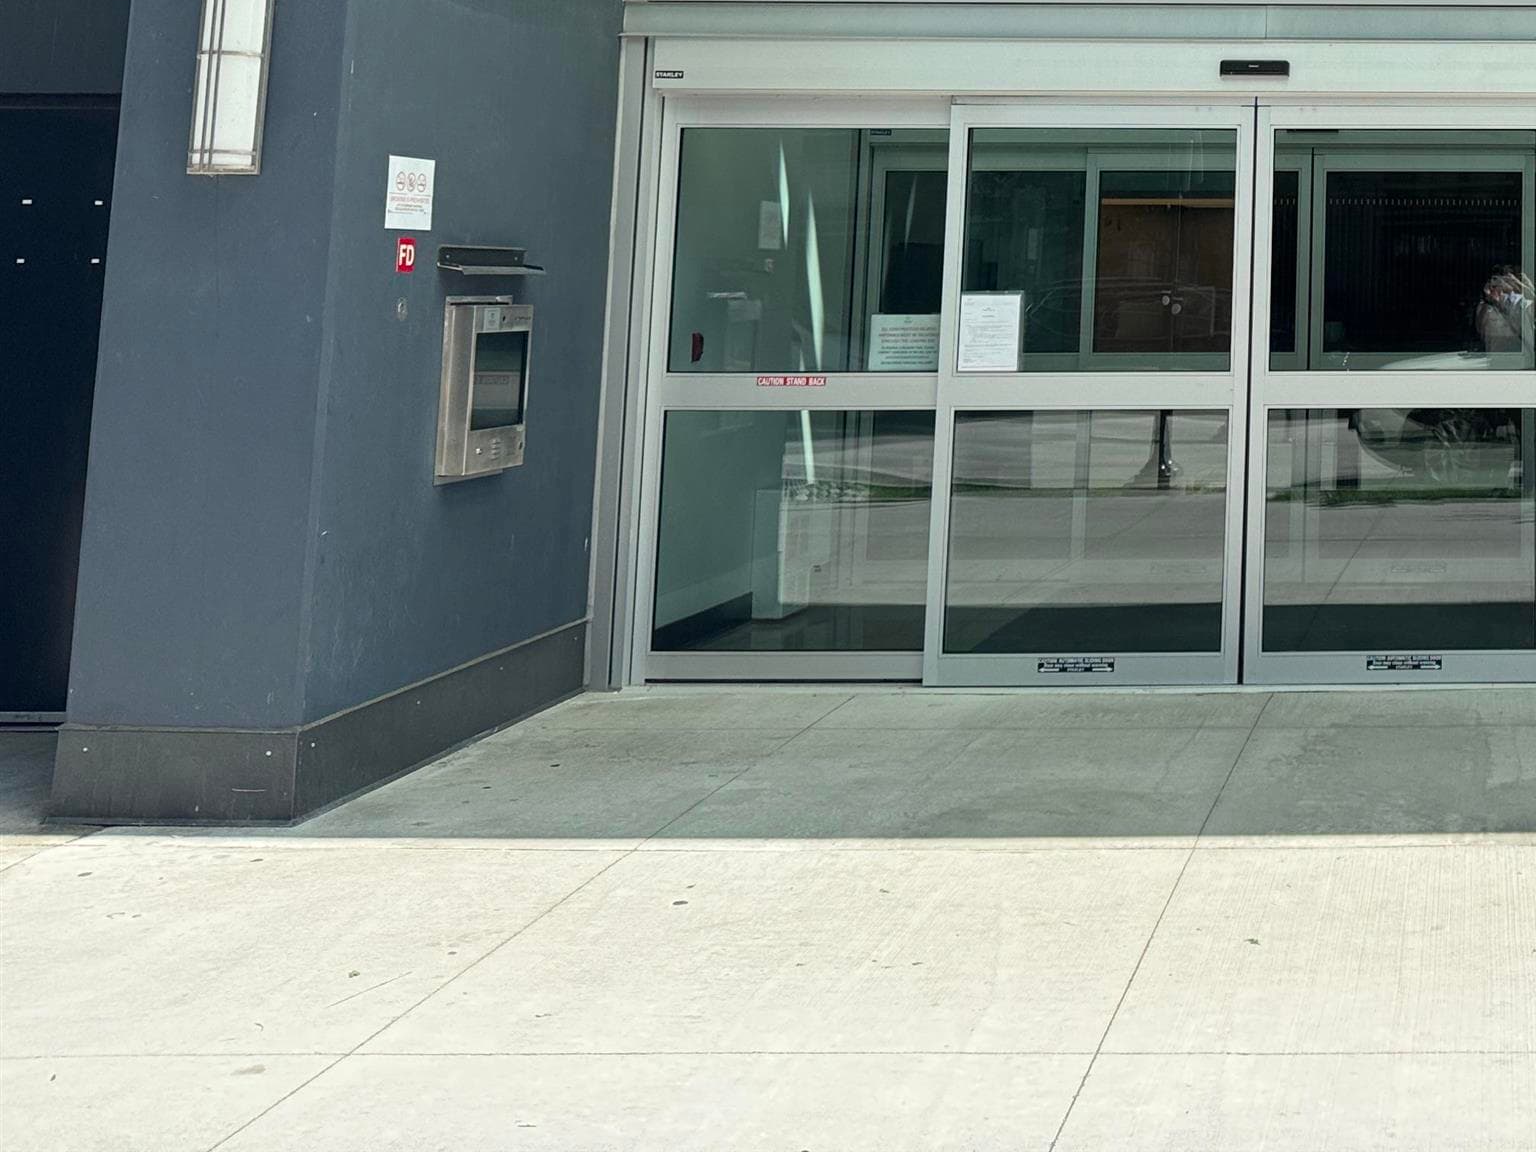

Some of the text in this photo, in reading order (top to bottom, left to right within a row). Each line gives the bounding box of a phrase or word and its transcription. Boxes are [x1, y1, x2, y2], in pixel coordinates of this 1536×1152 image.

[398, 243, 415, 267] FD
[757, 377, 825, 386] CAUTION STAND BACK
